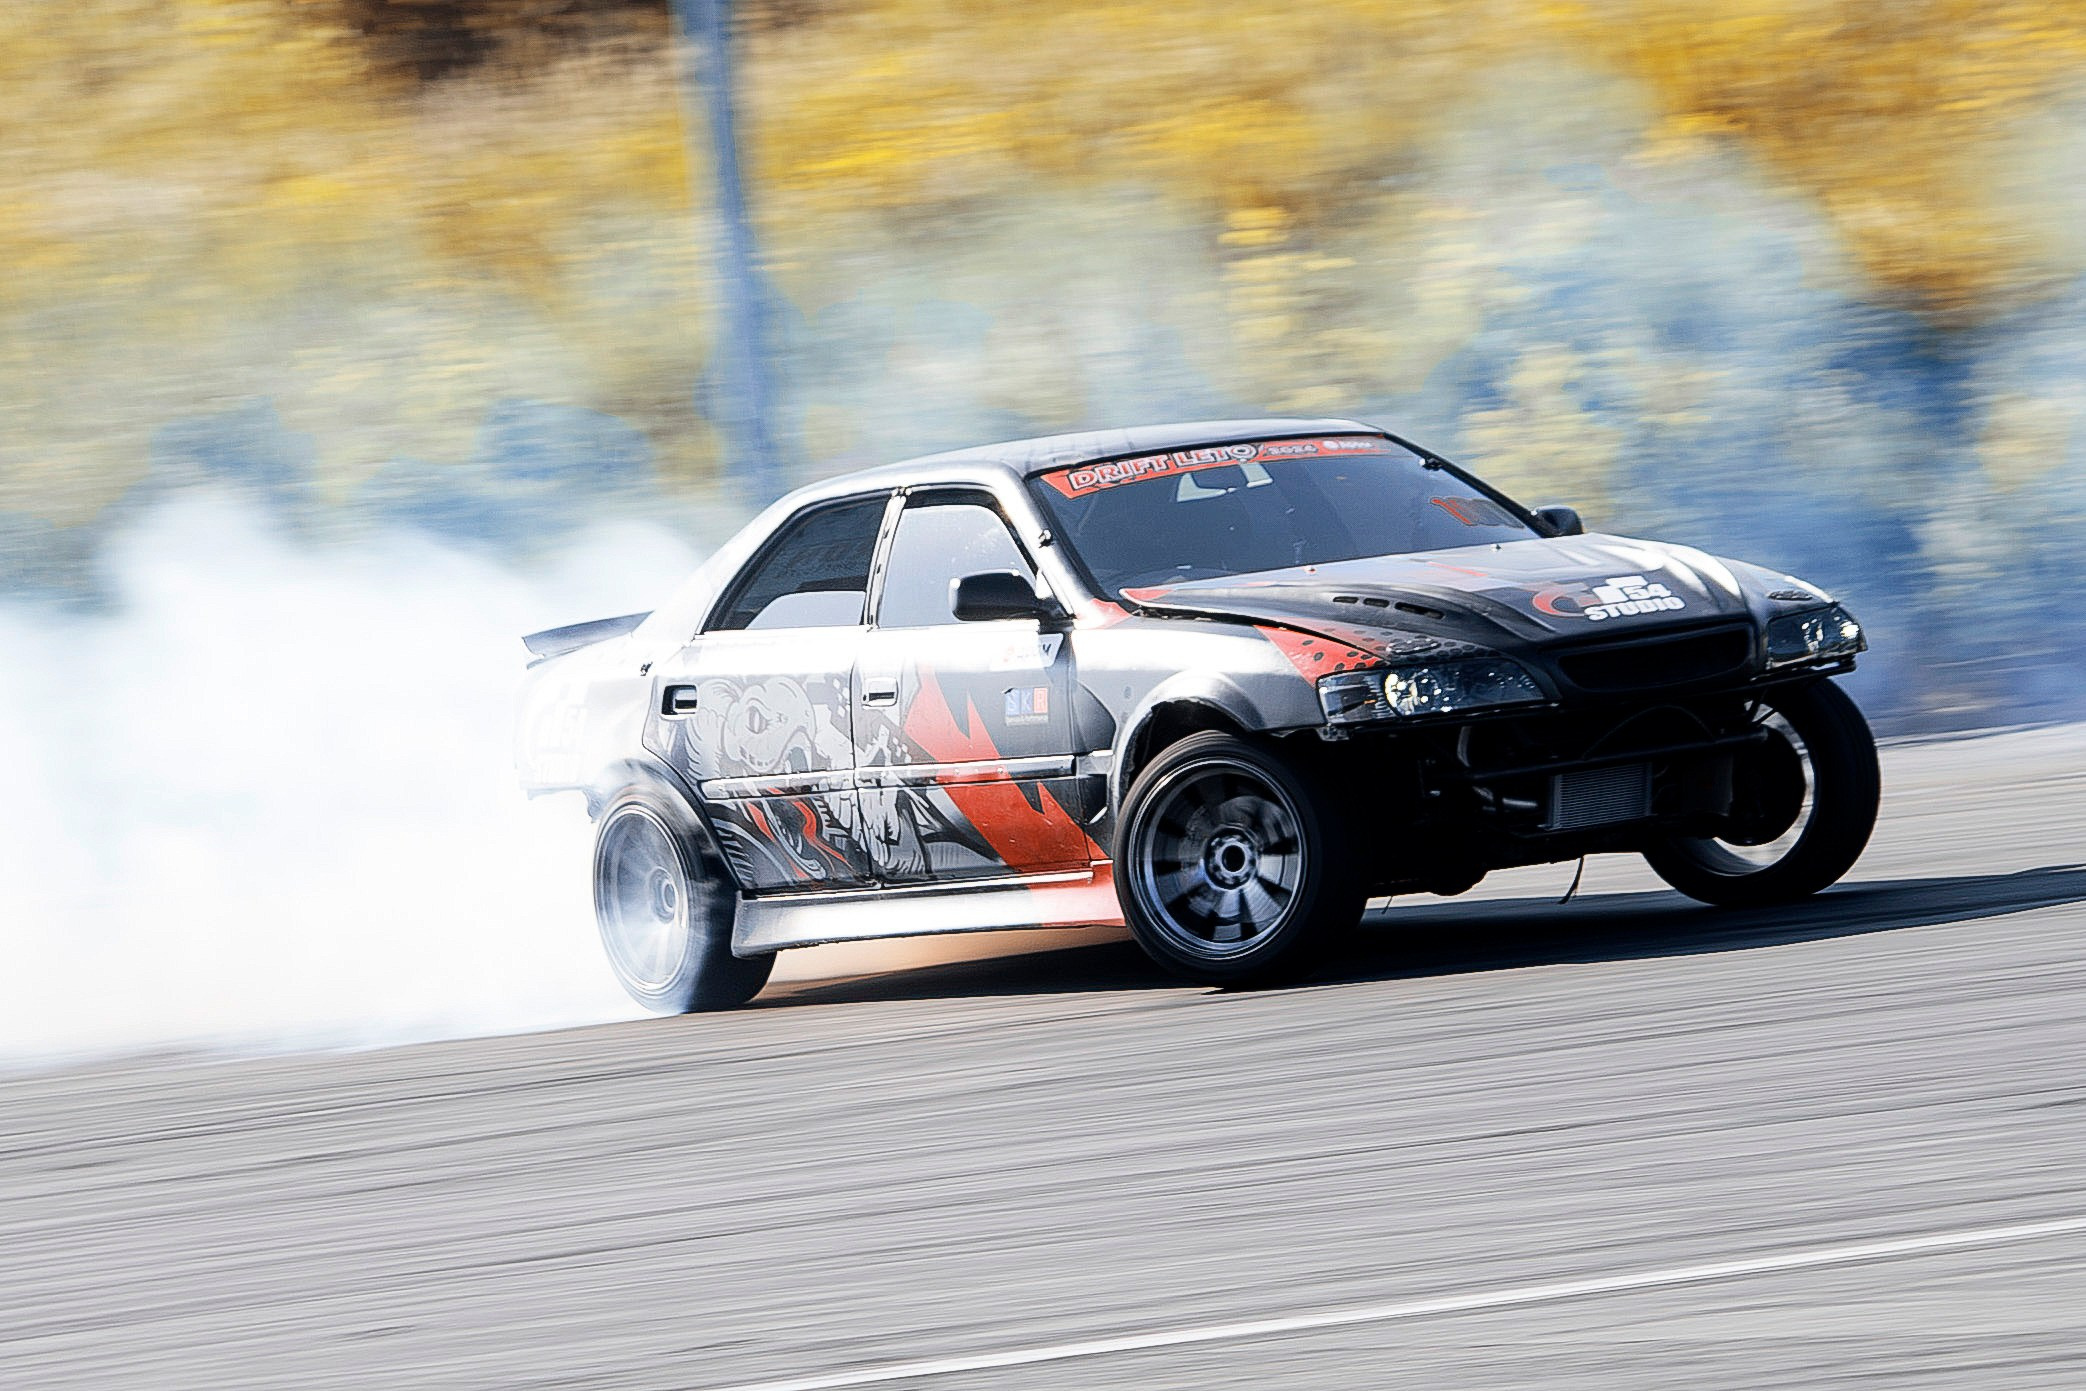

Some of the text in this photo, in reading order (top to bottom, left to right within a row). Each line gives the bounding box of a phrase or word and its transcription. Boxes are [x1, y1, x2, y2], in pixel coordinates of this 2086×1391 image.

[1068, 456, 1169, 490] DRIFT
[1174, 444, 1257, 466] LETO
[1584, 596, 1686, 621] STUDIO
